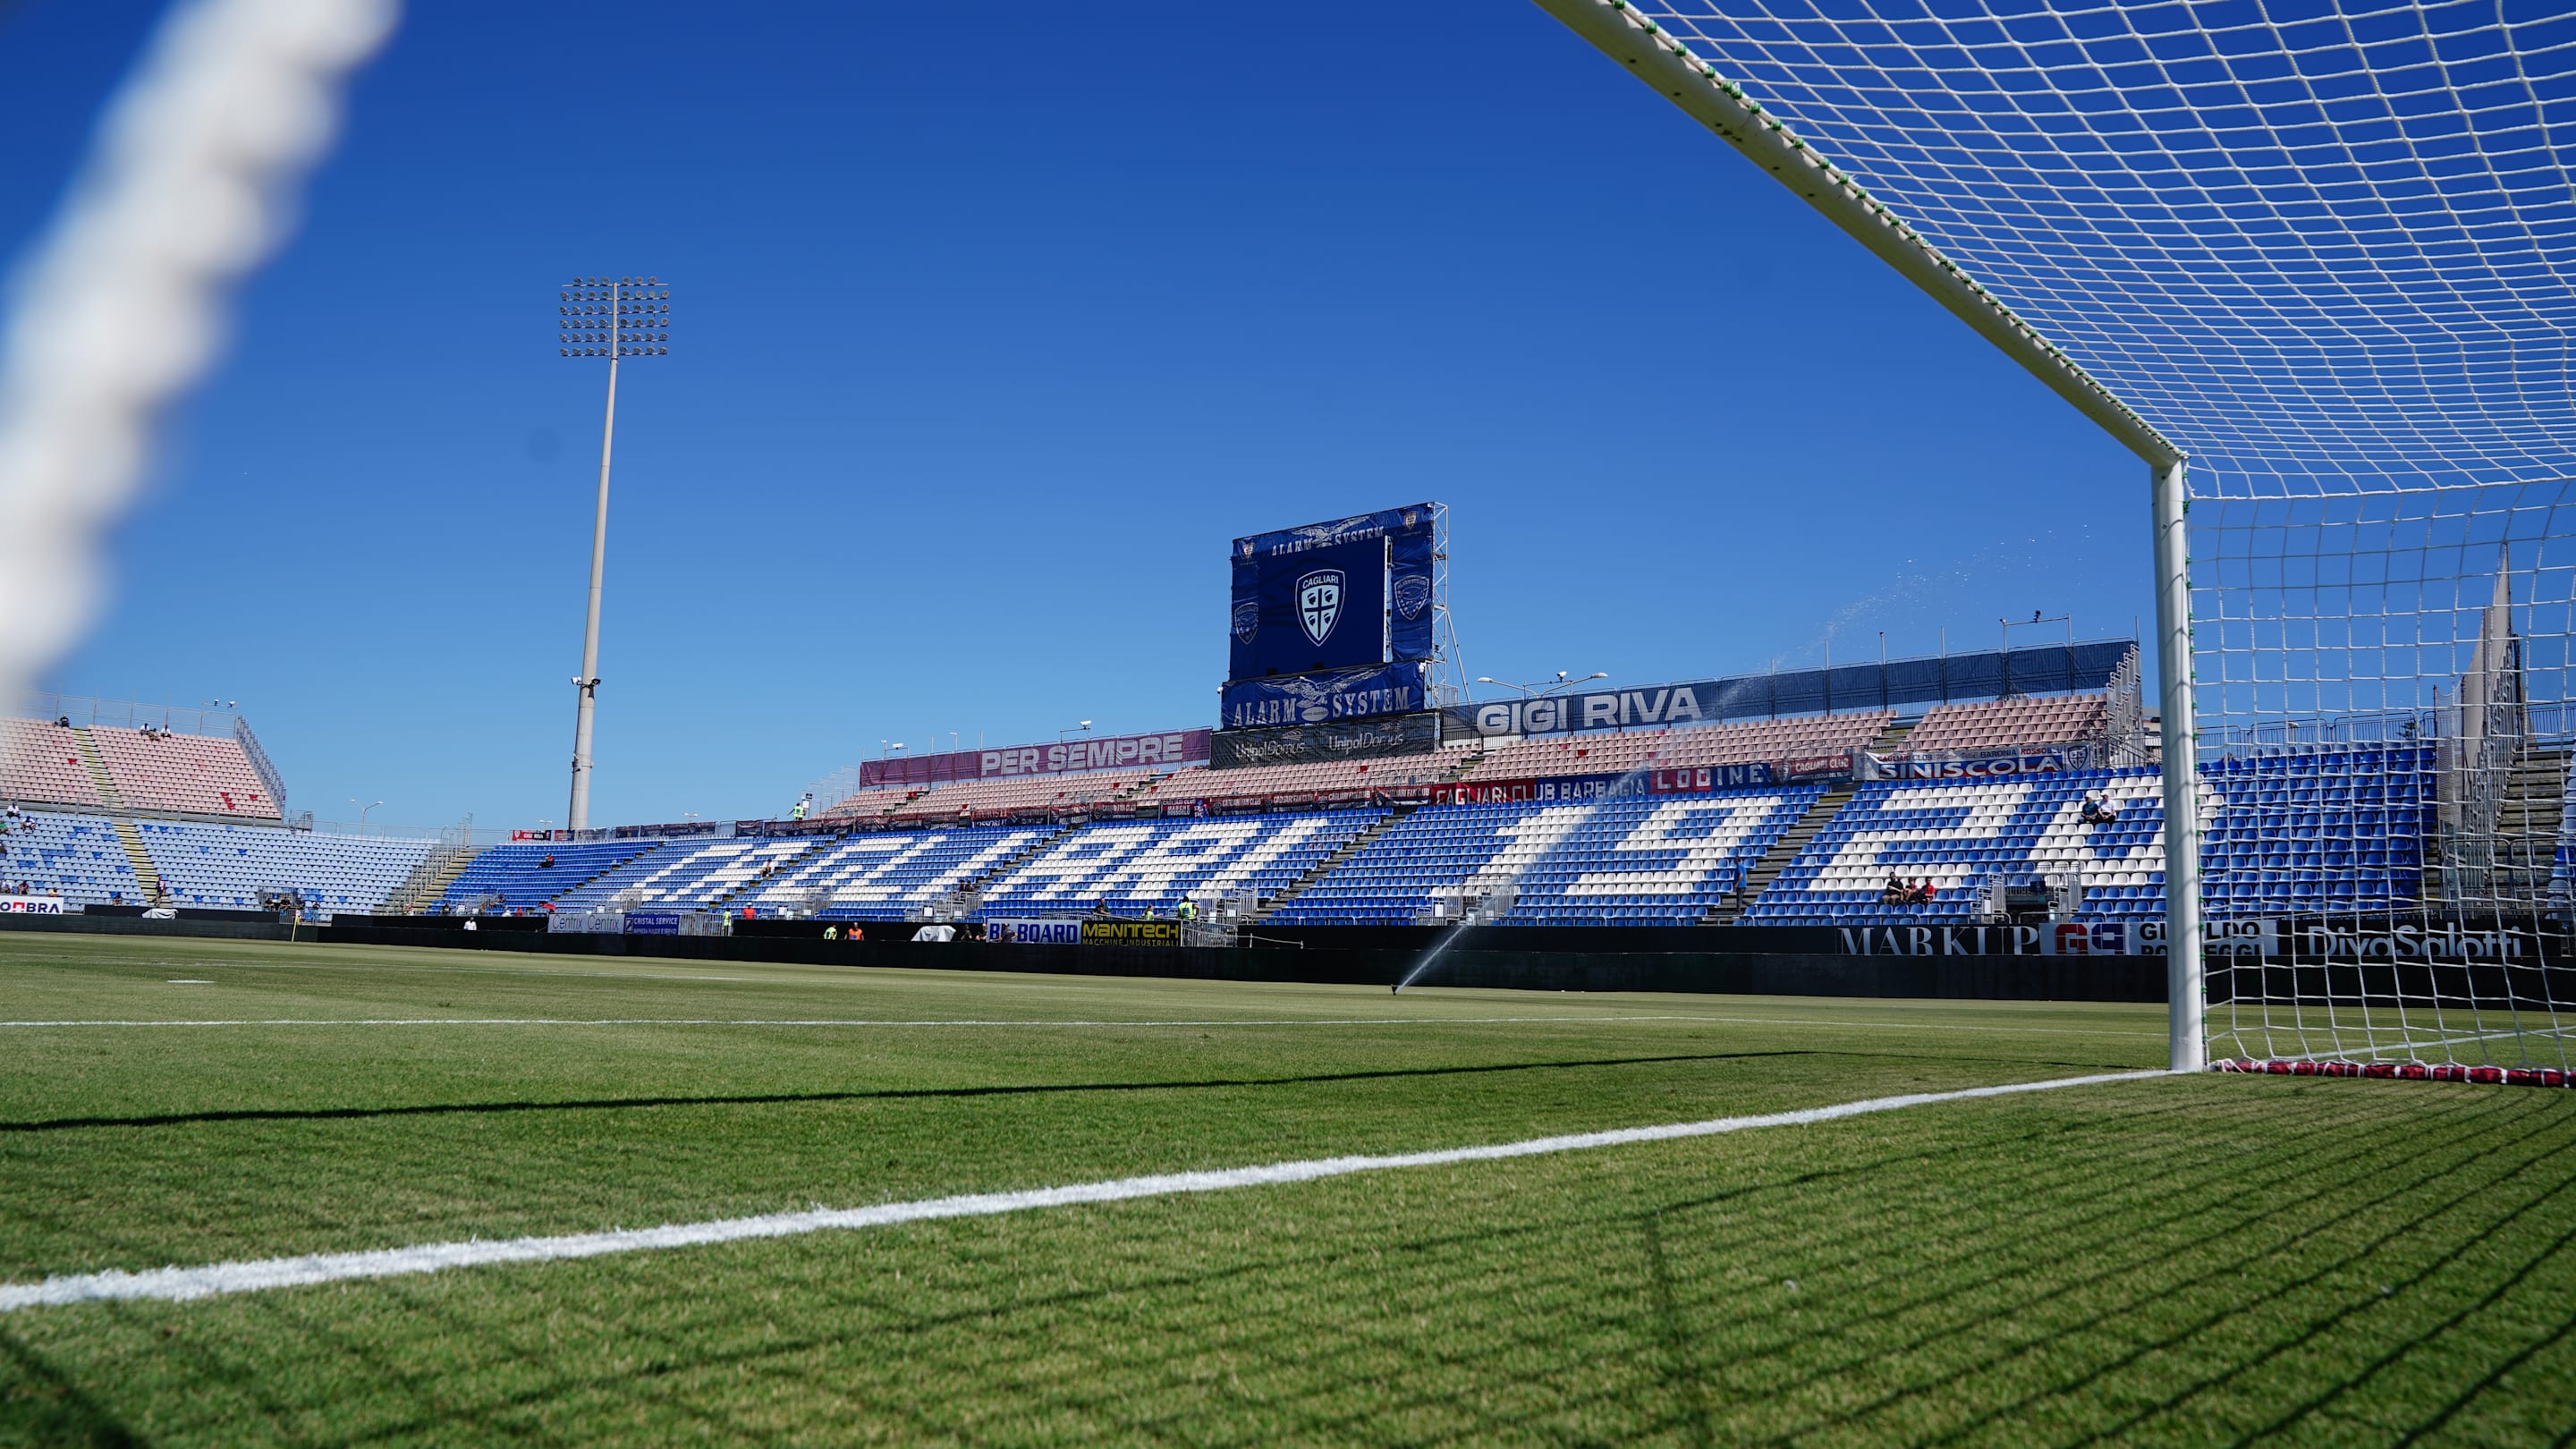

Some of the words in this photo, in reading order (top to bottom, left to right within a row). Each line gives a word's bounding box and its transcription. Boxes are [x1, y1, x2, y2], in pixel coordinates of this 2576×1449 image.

[1272, 538, 1313, 555] ALARM
[1335, 526, 1384, 545] SYSTEM
[1302, 575, 1339, 589] CAGLIARI
[1233, 698, 1297, 726] ALARM
[1332, 686, 1410, 718] SYSTEM
[1477, 699, 1568, 735] GIGI
[1583, 687, 1703, 728] RIVA
[1235, 740, 1306, 760] UnipolDomus
[1328, 732, 1404, 755] UnipolDomus
[980, 749, 1040, 776] PER
[1047, 733, 1183, 771] SEMPRE
[1877, 755, 1911, 763] CAGLIARI
[1913, 753, 1932, 761] CLUB
[1980, 750, 2017, 758] BARONIA
[1795, 761, 1827, 773] CAGLIARI
[1829, 758, 1850, 769] CLUB
[1878, 756, 2063, 780] SINISCOLA
[1657, 764, 1765, 790] LODINE
[1436, 785, 1507, 806] CAGLIARI
[1513, 783, 1555, 802] CLUB
[1561, 778, 1646, 801] BARBAGIA
[552, 913, 582, 929] Centrix
[587, 914, 620, 930] Centrix
[634, 917, 655, 925] CRISTAL
[655, 917, 679, 925] SERVICE
[1018, 923, 1079, 943] BOARD
[1126, 938, 1179, 947] INDUSTRIALI
[2308, 922, 2522, 958] DivaSalotti
